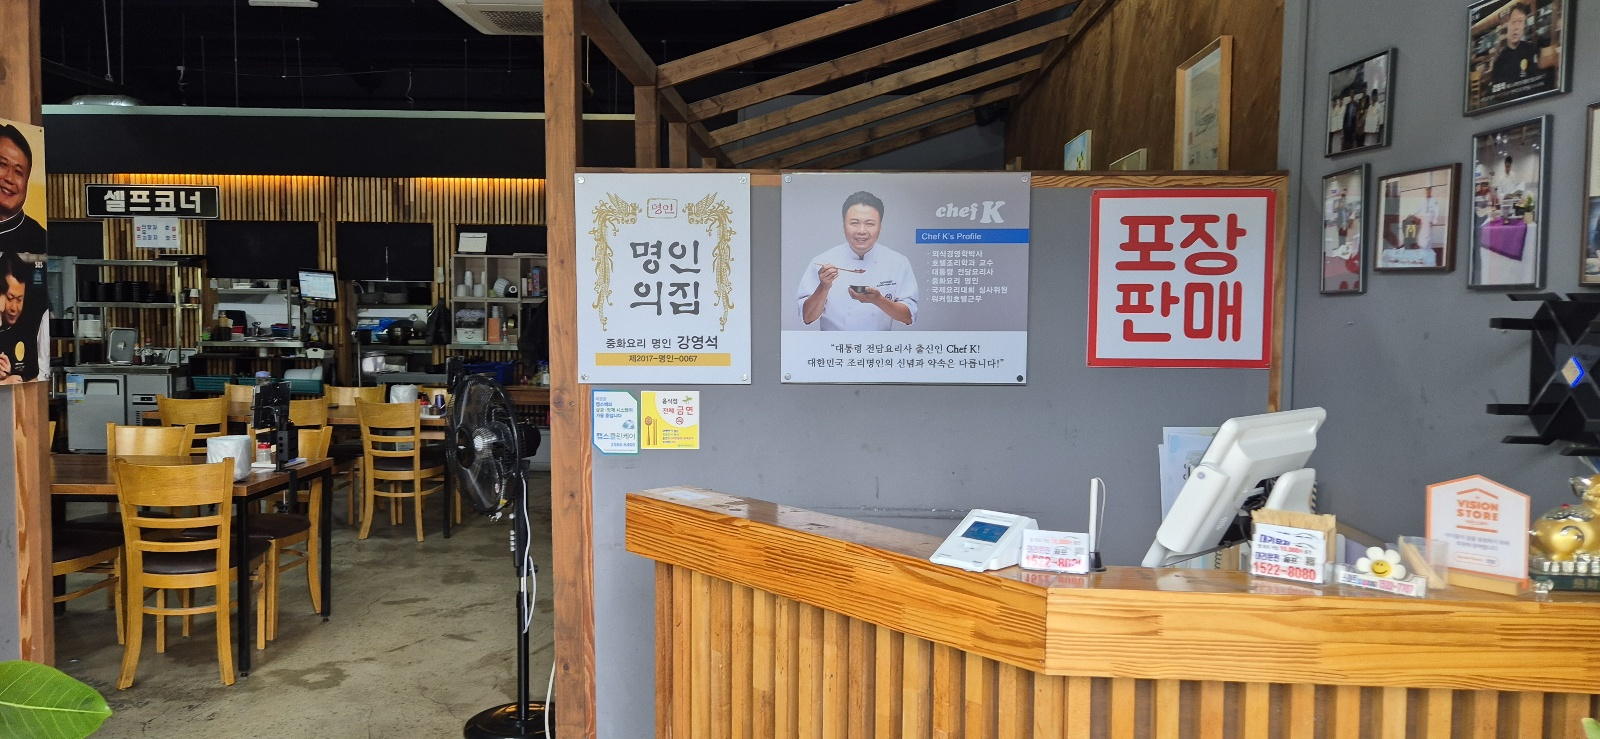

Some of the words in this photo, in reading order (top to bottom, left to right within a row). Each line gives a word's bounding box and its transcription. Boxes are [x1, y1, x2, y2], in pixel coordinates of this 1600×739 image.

[104, 190, 202, 213] 셀프코너
[651, 203, 674, 215] 명인
[936, 203, 978, 220] chef
[980, 201, 1006, 223] K
[1115, 213, 1247, 276] 포장
[630, 240, 701, 274] 명인
[630, 281, 700, 316] 의집
[1115, 281, 1243, 342] 판매
[606, 338, 646, 349] 중화요리
[651, 338, 671, 349] 명인
[677, 335, 718, 350] 강영석
[866, 344, 912, 354] 전담요리사
[946, 344, 967, 354] Chef
[969, 344, 980, 354] K!
[628, 354, 698, 363] 제2017-명인-0067
[807, 358, 844, 368] 대한민국
[847, 358, 893, 368] 조리명인의
[897, 358, 924, 368] 신념과
[928, 359, 955, 369] 약속은
[1457, 500, 1498, 511] VISION
[1457, 509, 1498, 521] STORE
[1254, 562, 1316, 581] 1522-8080
